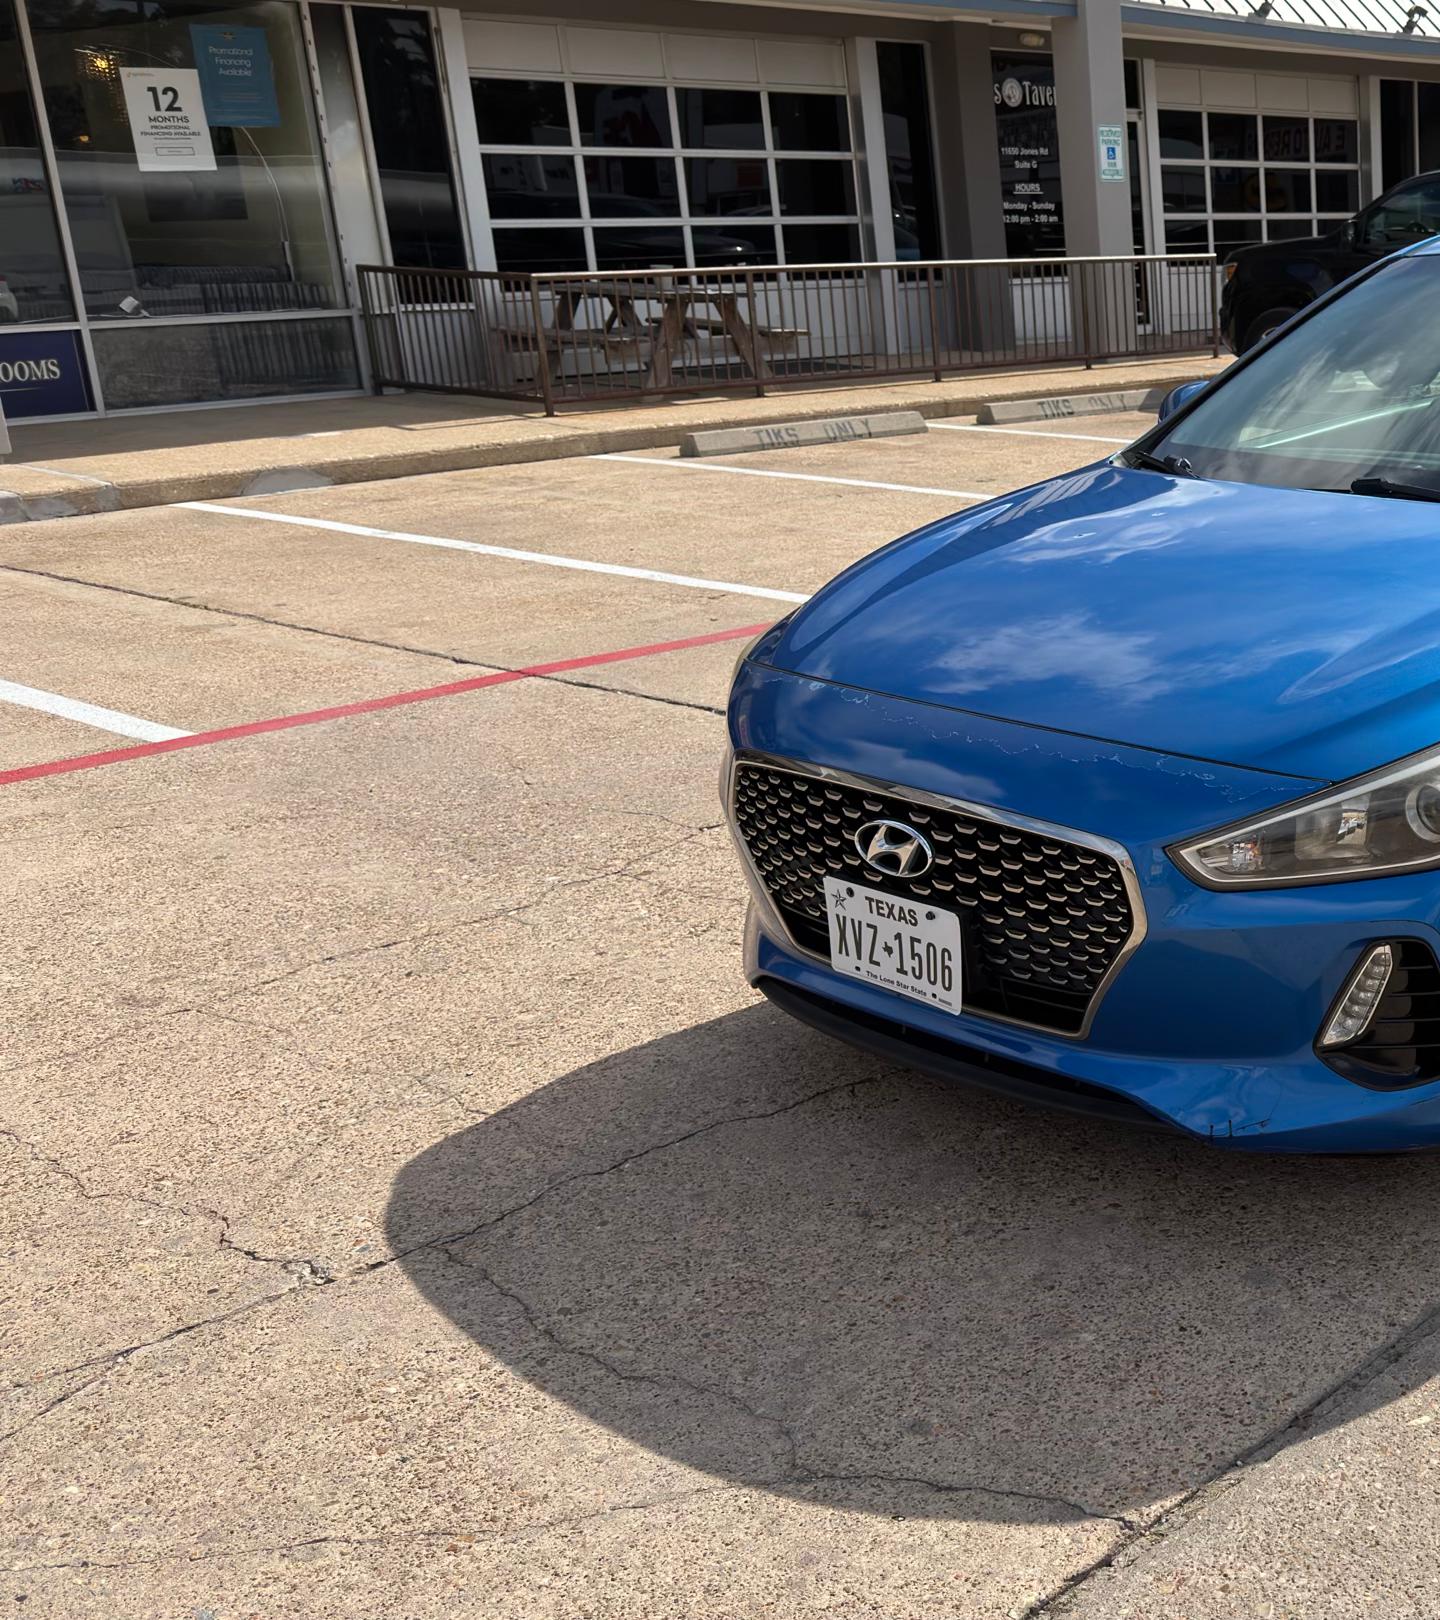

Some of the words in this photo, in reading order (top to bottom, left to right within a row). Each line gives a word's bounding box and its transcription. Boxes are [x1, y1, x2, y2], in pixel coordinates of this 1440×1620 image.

[146, 86, 183, 112] 12
[148, 115, 190, 124] MONTHS
[1020, 147, 1039, 156] Jones
[1015, 183, 1041, 192] HOURS
[1003, 202, 1028, 212] Monday
[1032, 201, 1056, 212] Sunday
[822, 417, 873, 441] ONLY
[864, 895, 919, 927] TEXAS
[866, 970, 878, 980] The
[879, 974, 895, 985] Lone
[896, 980, 910, 991] Star
[910, 985, 928, 997] State
